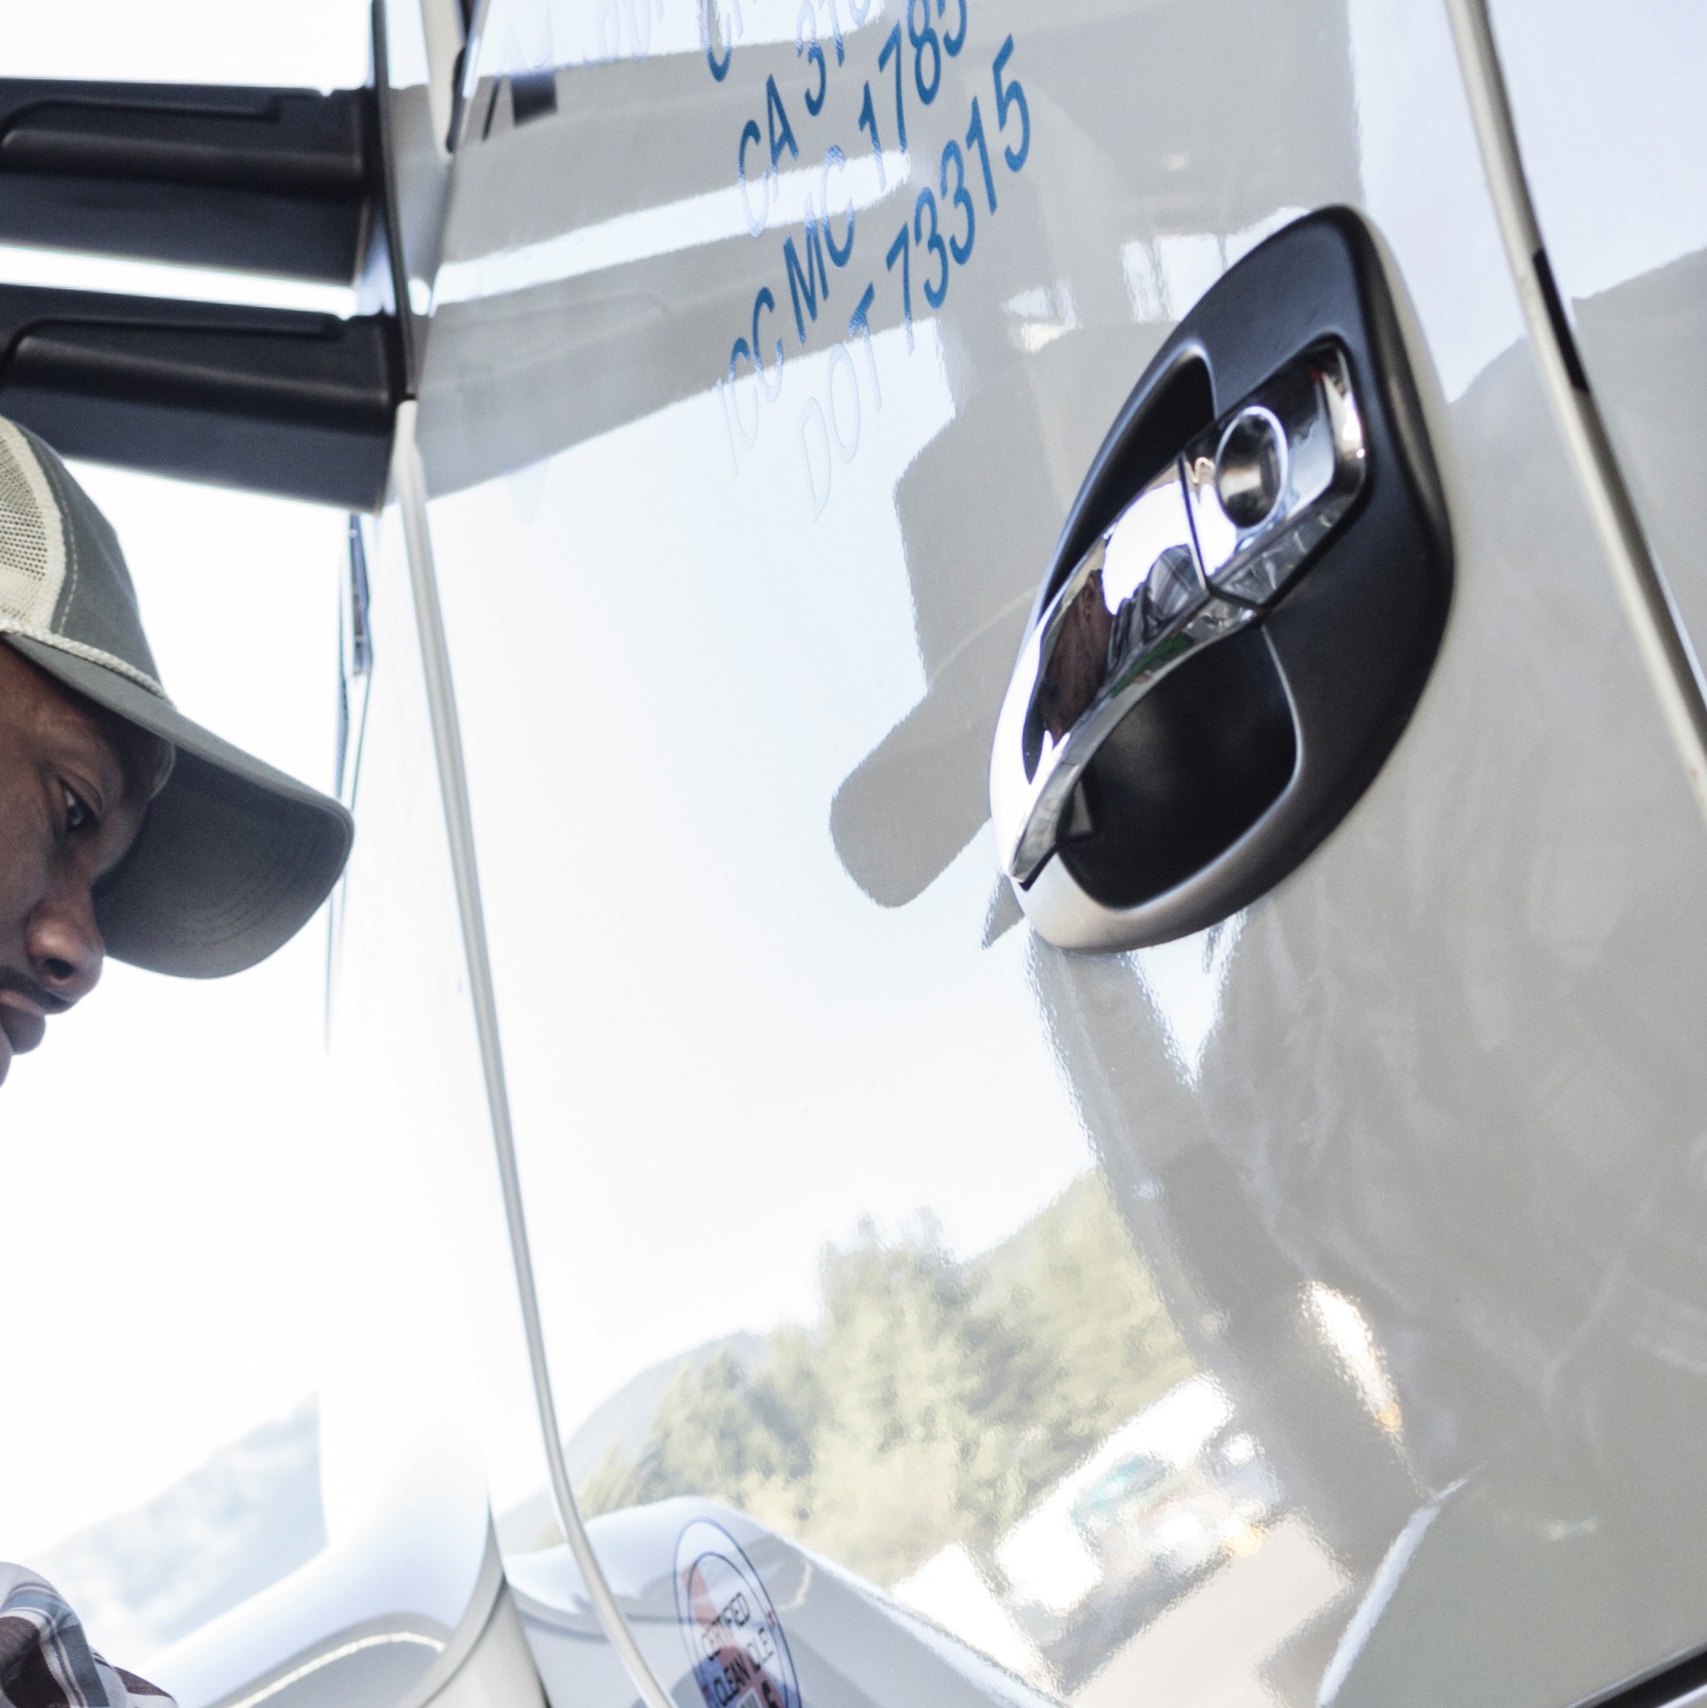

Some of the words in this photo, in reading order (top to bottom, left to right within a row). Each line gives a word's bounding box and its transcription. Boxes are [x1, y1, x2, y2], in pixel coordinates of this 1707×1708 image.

[737, 72, 800, 239] CA
[795, 0, 873, 117] 31
[715, 286, 784, 480] ICC
[783, 144, 855, 348] MC
[798, 281, 883, 526] DOT
[885, 32, 1031, 357] 73315
[712, 1651, 751, 1708] CLEAN
